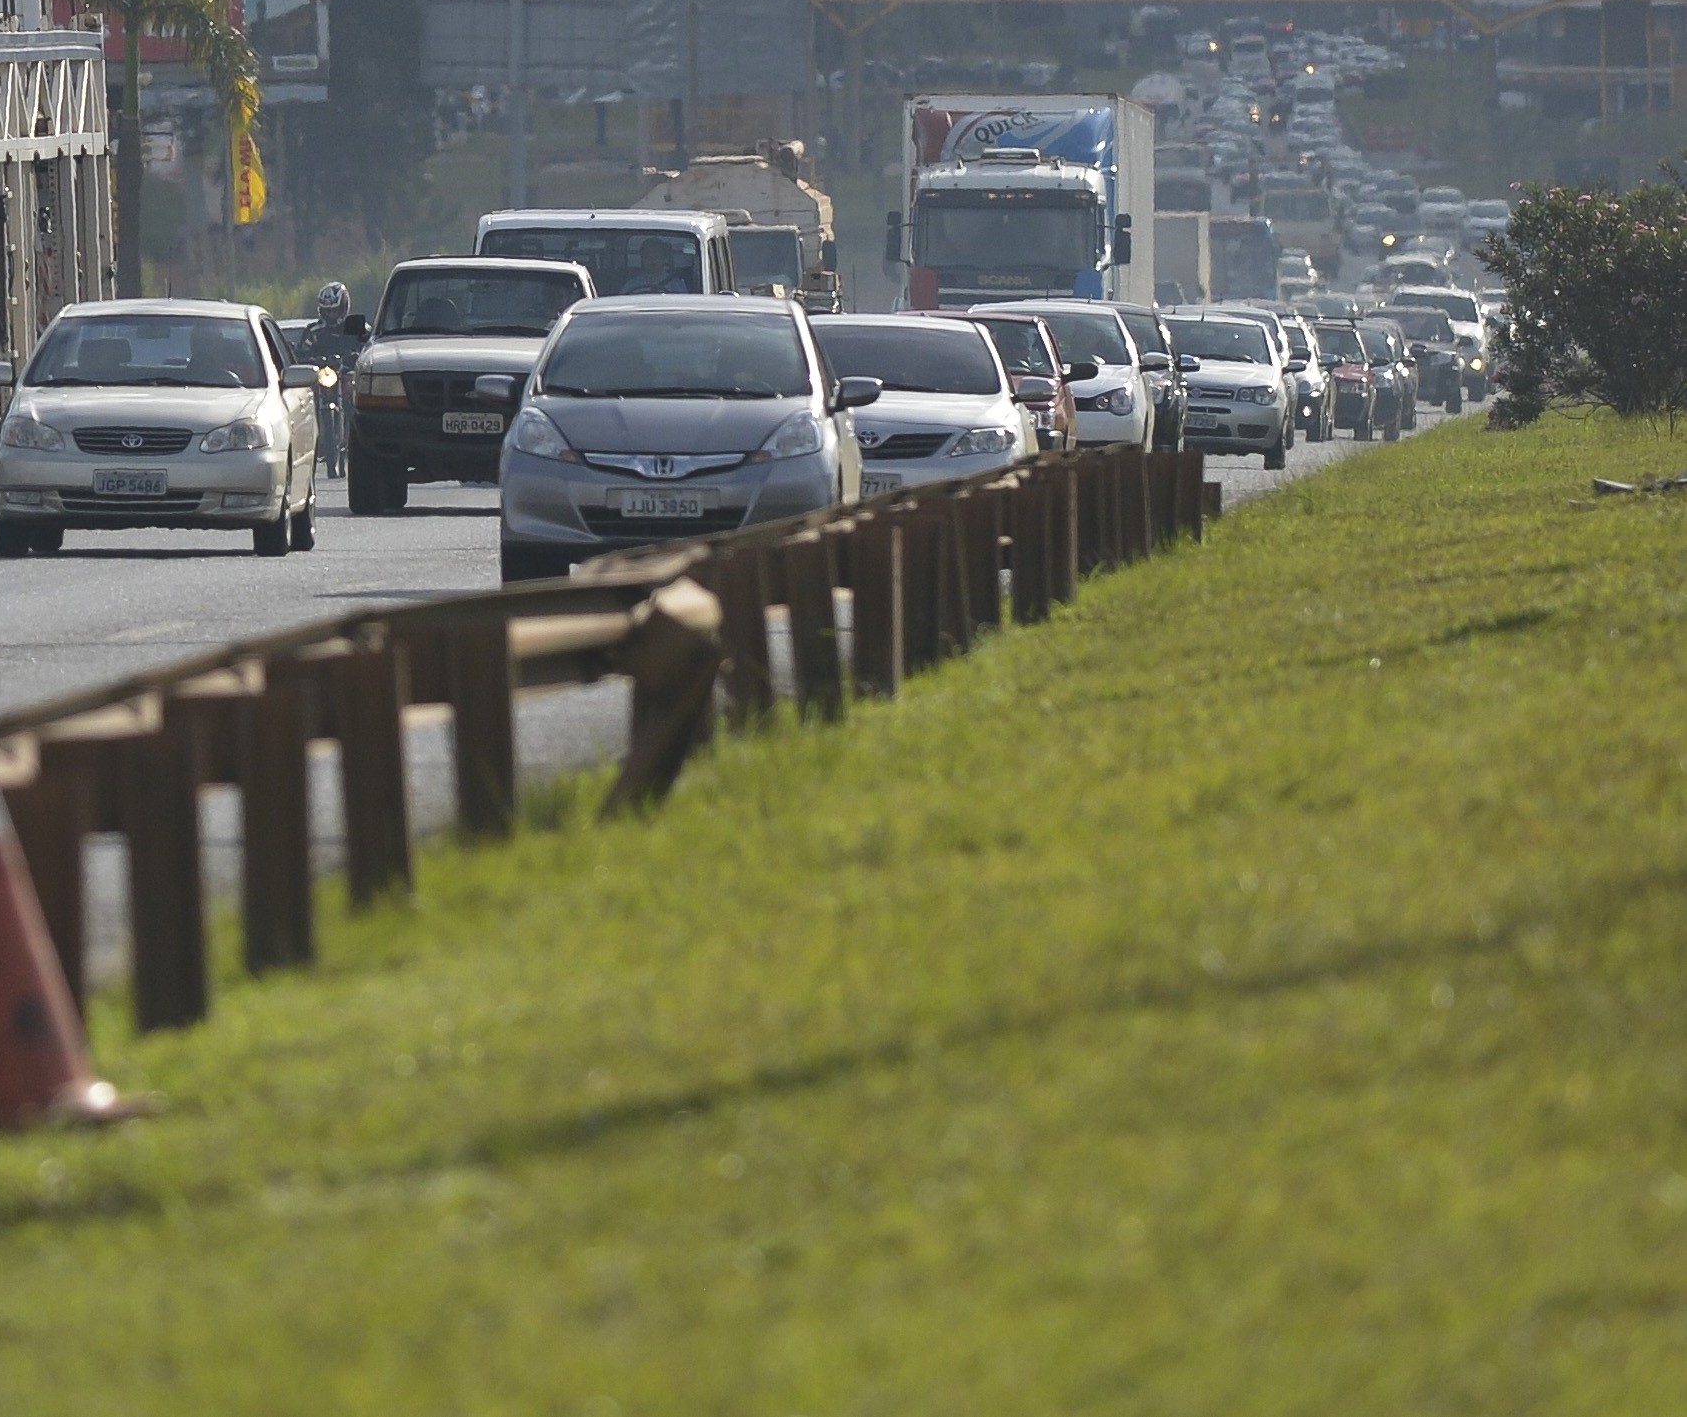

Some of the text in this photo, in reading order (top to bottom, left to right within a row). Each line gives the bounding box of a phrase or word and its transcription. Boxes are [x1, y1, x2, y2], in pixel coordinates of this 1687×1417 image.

[974, 111, 1039, 144] QUICK
[977, 275, 1032, 286] SCANIA
[97, 479, 126, 493] JGP
[626, 499, 656, 514] JJU
